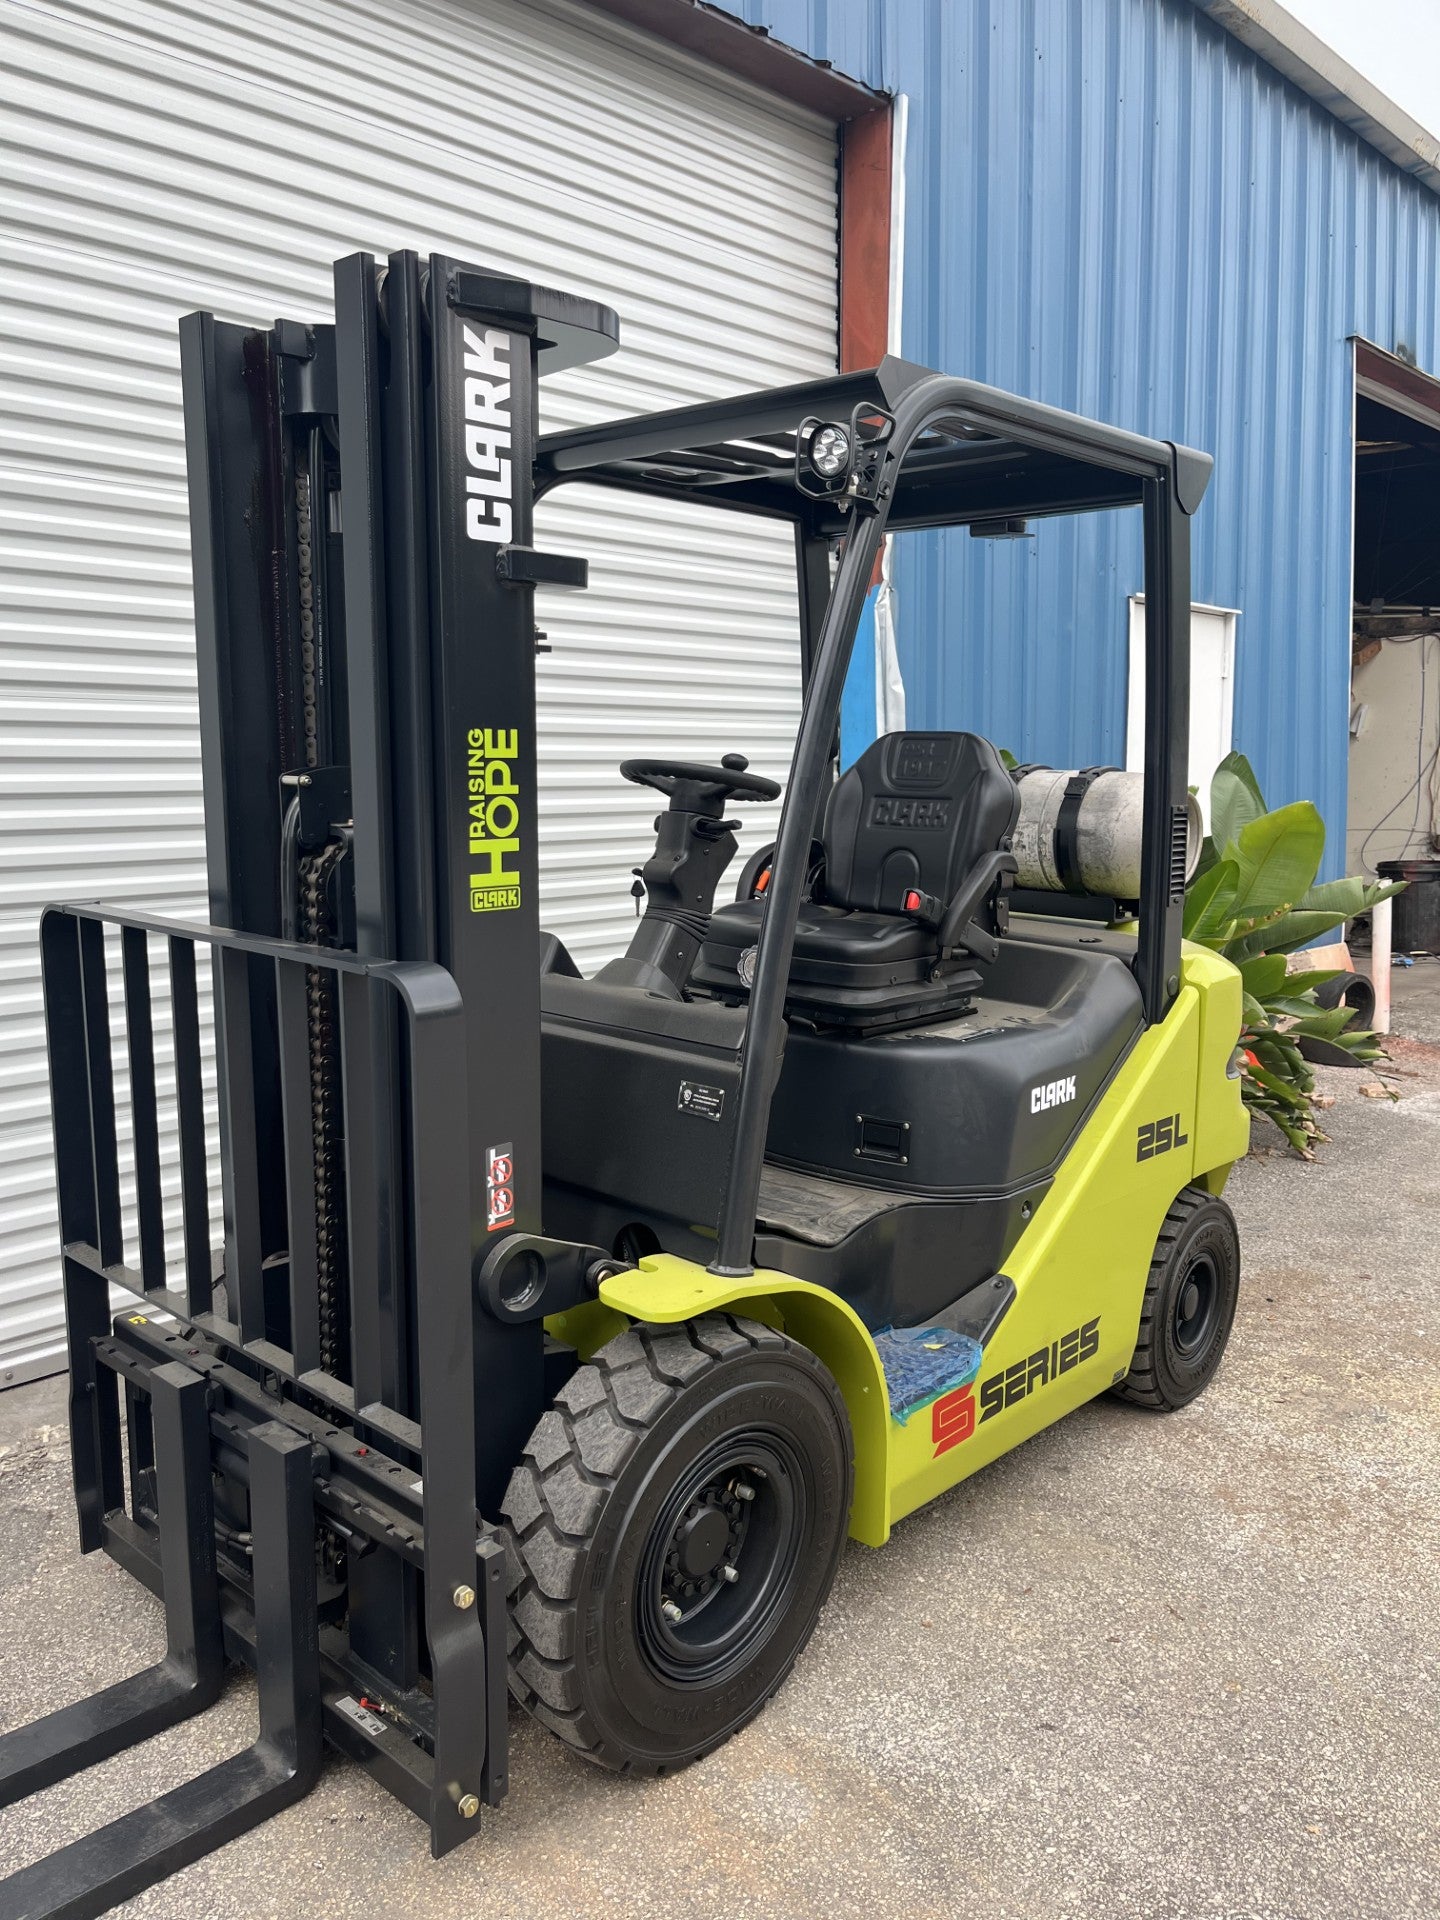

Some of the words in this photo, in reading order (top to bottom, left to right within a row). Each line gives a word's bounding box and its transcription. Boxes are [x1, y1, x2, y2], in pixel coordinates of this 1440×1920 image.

[463, 324, 512, 543] CLARK
[468, 728, 486, 838] RAISING
[469, 728, 520, 888] HOPE
[876, 800, 949, 826] CLARK
[473, 889, 518, 909] CLARK
[1031, 1075, 1077, 1114] CLARK
[1136, 1113, 1188, 1163] 25L
[932, 1381, 976, 1460] S
[978, 1315, 1102, 1425] SERIES
